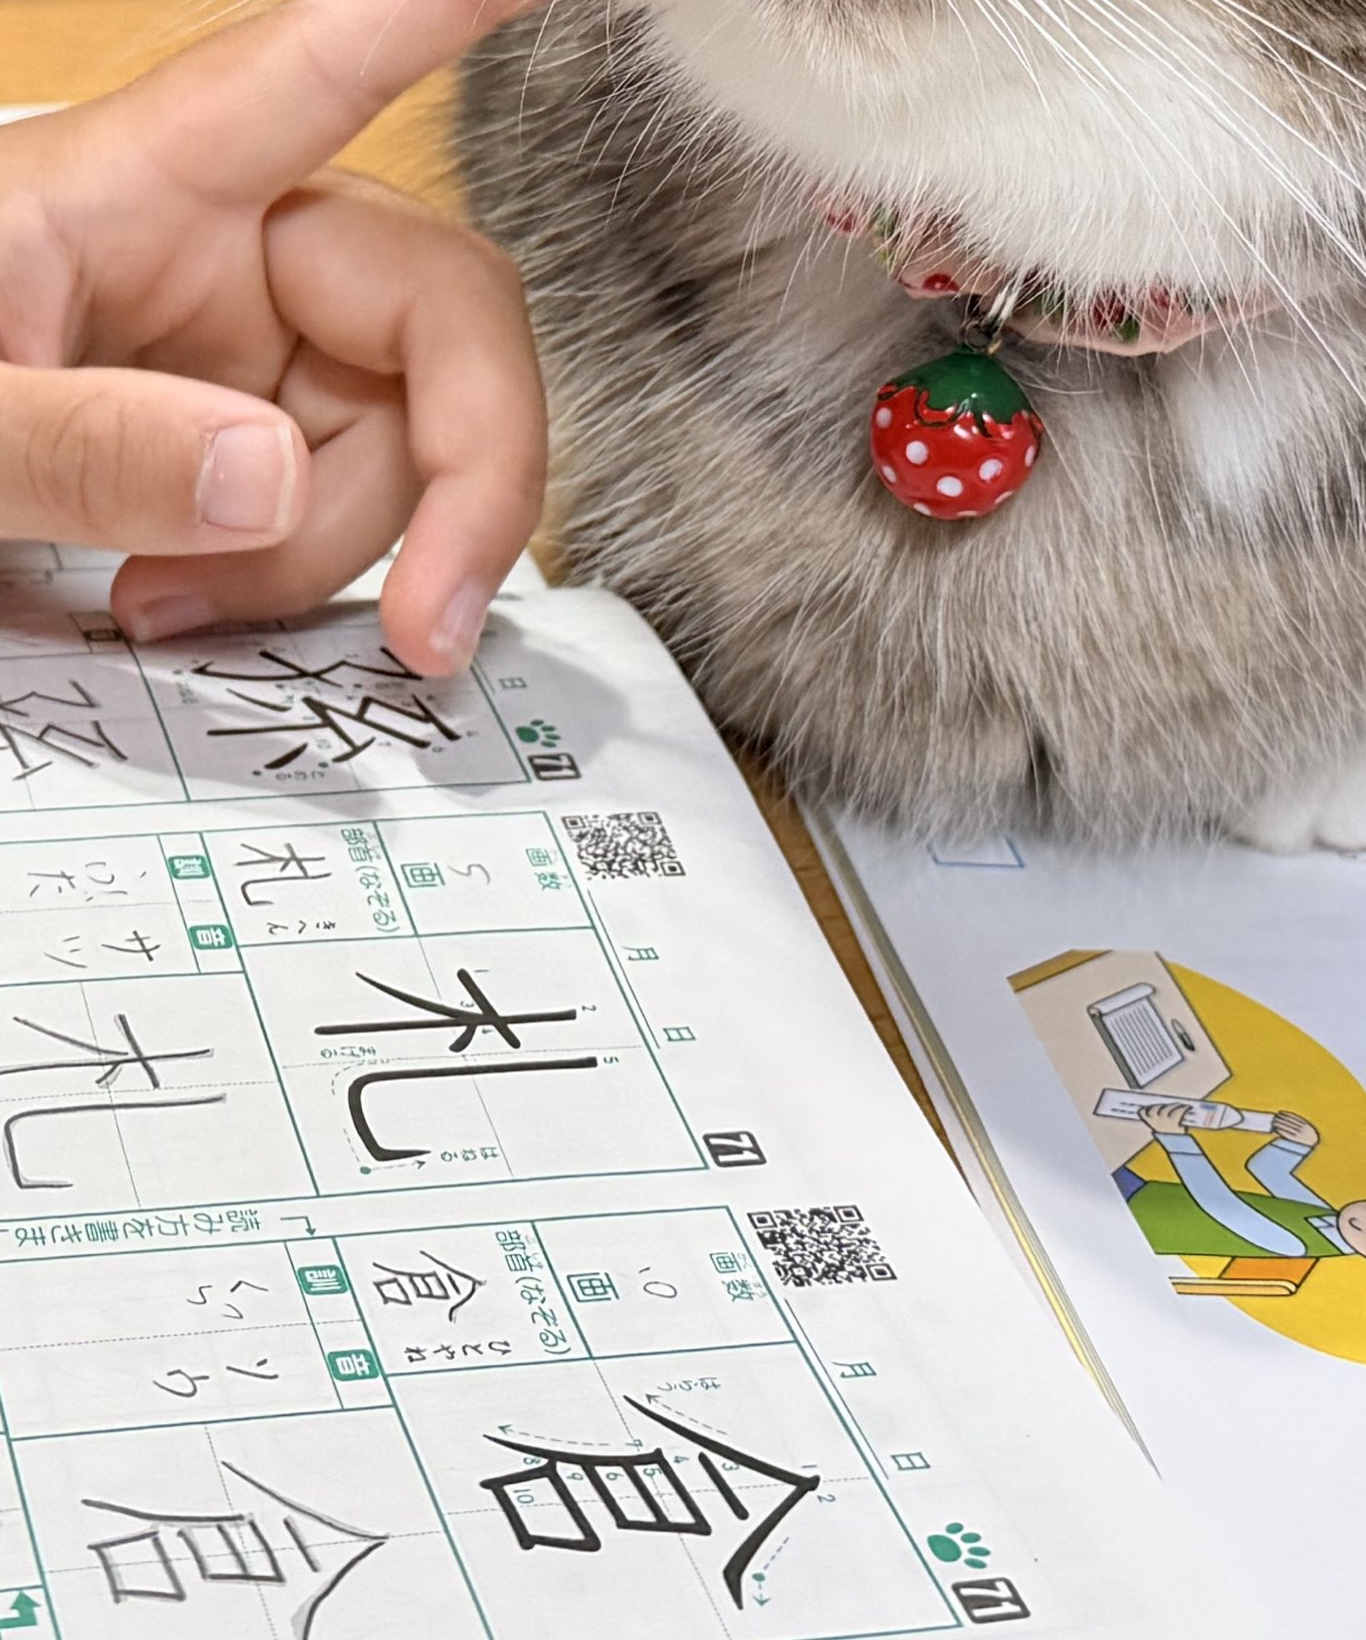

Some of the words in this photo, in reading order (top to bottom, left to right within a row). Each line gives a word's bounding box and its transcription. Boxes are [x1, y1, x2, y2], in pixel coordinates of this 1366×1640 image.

[191, 647, 461, 769] 孫
[528, 753, 578, 781] 71
[235, 843, 332, 906] 札
[340, 828, 401, 933] 部首(なぞる)
[401, 863, 445, 888] 画
[526, 848, 563, 890] 画数
[195, 928, 228, 946] 音
[266, 921, 337, 935] きへん
[44, 930, 161, 968] サツ
[623, 947, 659, 960] 月
[662, 1027, 696, 1041] 日
[315, 969, 598, 1162] 札
[707, 1135, 765, 1163] 71
[371, 1250, 487, 1323] 倉
[494, 1230, 573, 1355] 部首(なぞる)
[566, 1272, 620, 1303] 画
[709, 1252, 758, 1302] 画数
[333, 1352, 374, 1377] 音
[403, 1339, 513, 1363] ひとやね
[832, 1361, 877, 1379] 月
[153, 1358, 279, 1399] ソウ
[891, 1452, 931, 1471] 日
[479, 1394, 822, 1610] 倉
[82, 1461, 389, 1640] 倉
[959, 1581, 1023, 1621] 71
